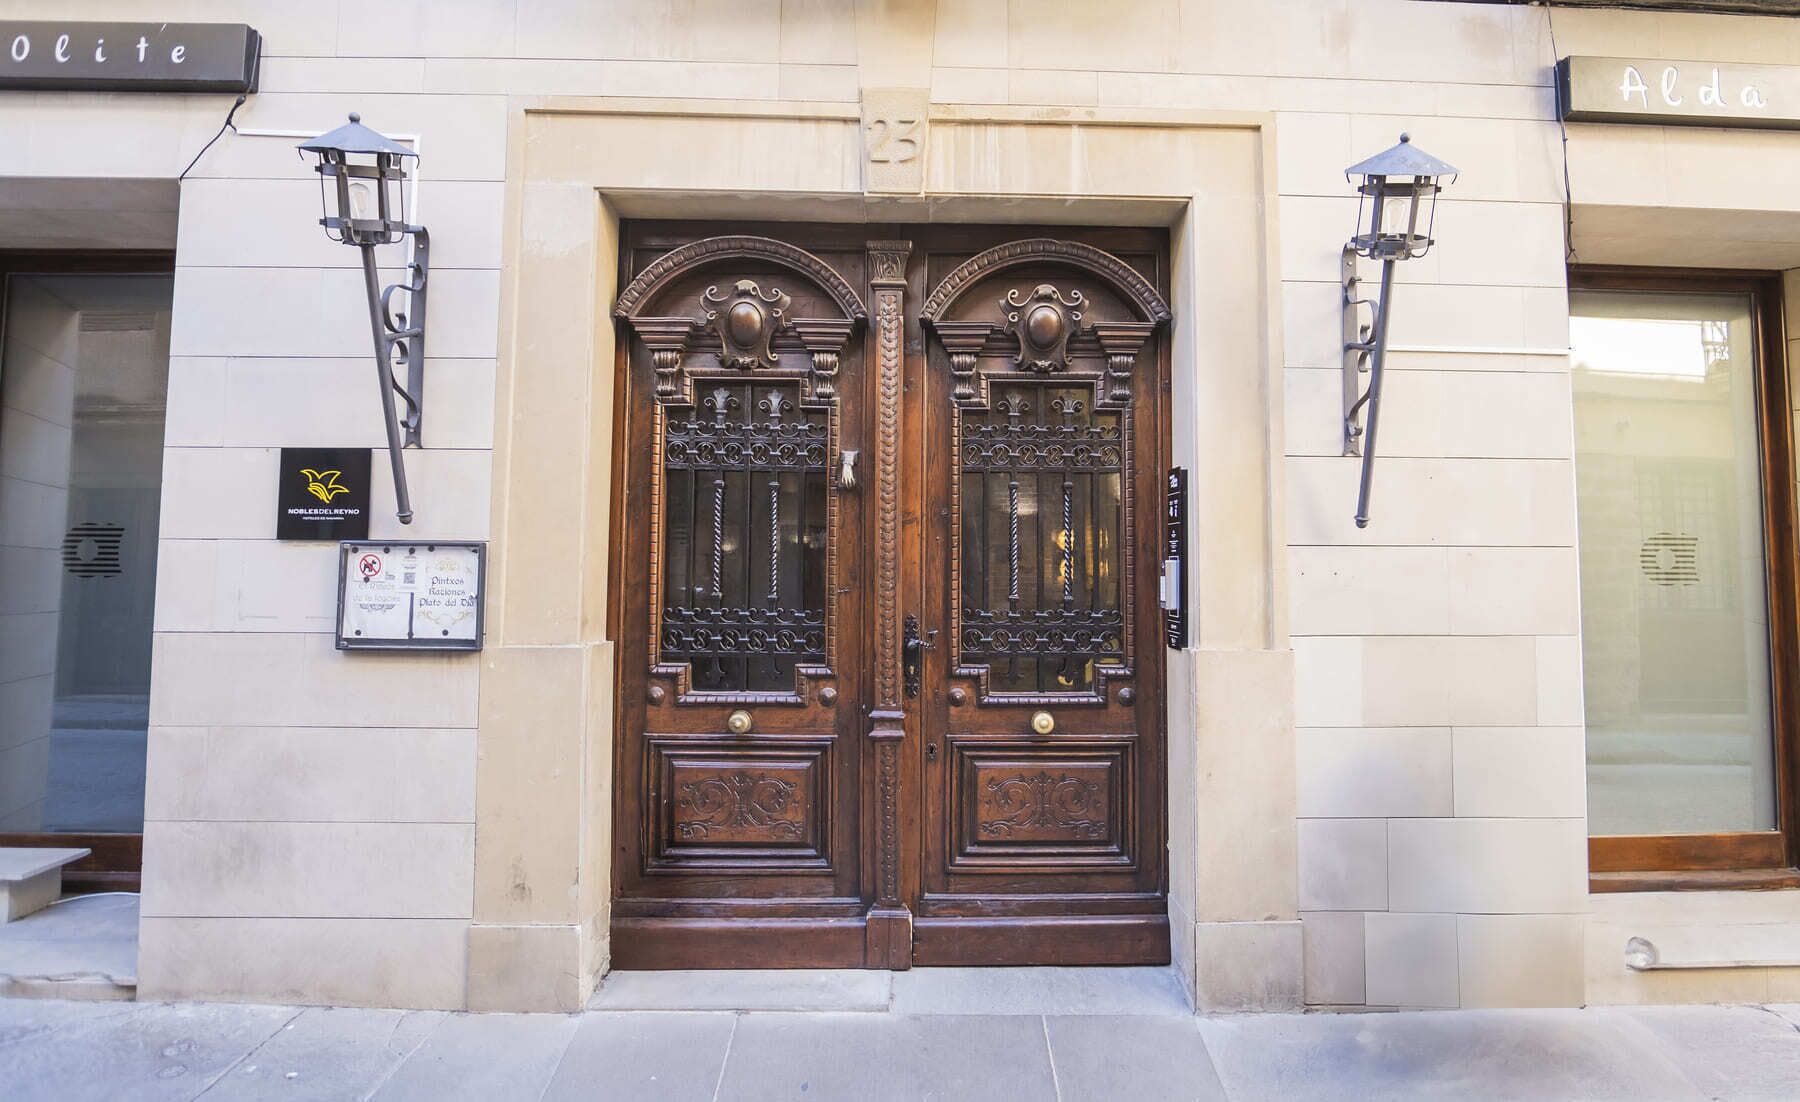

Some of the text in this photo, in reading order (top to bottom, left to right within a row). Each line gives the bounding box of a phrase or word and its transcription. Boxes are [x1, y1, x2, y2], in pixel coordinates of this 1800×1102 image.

[11, 34, 186, 64] Olite
[1618, 65, 1768, 110] Alda
[866, 118, 918, 164] 23
[431, 576, 465, 587] Pintxos
[419, 598, 442, 608] Plato
[445, 598, 456, 607] del
